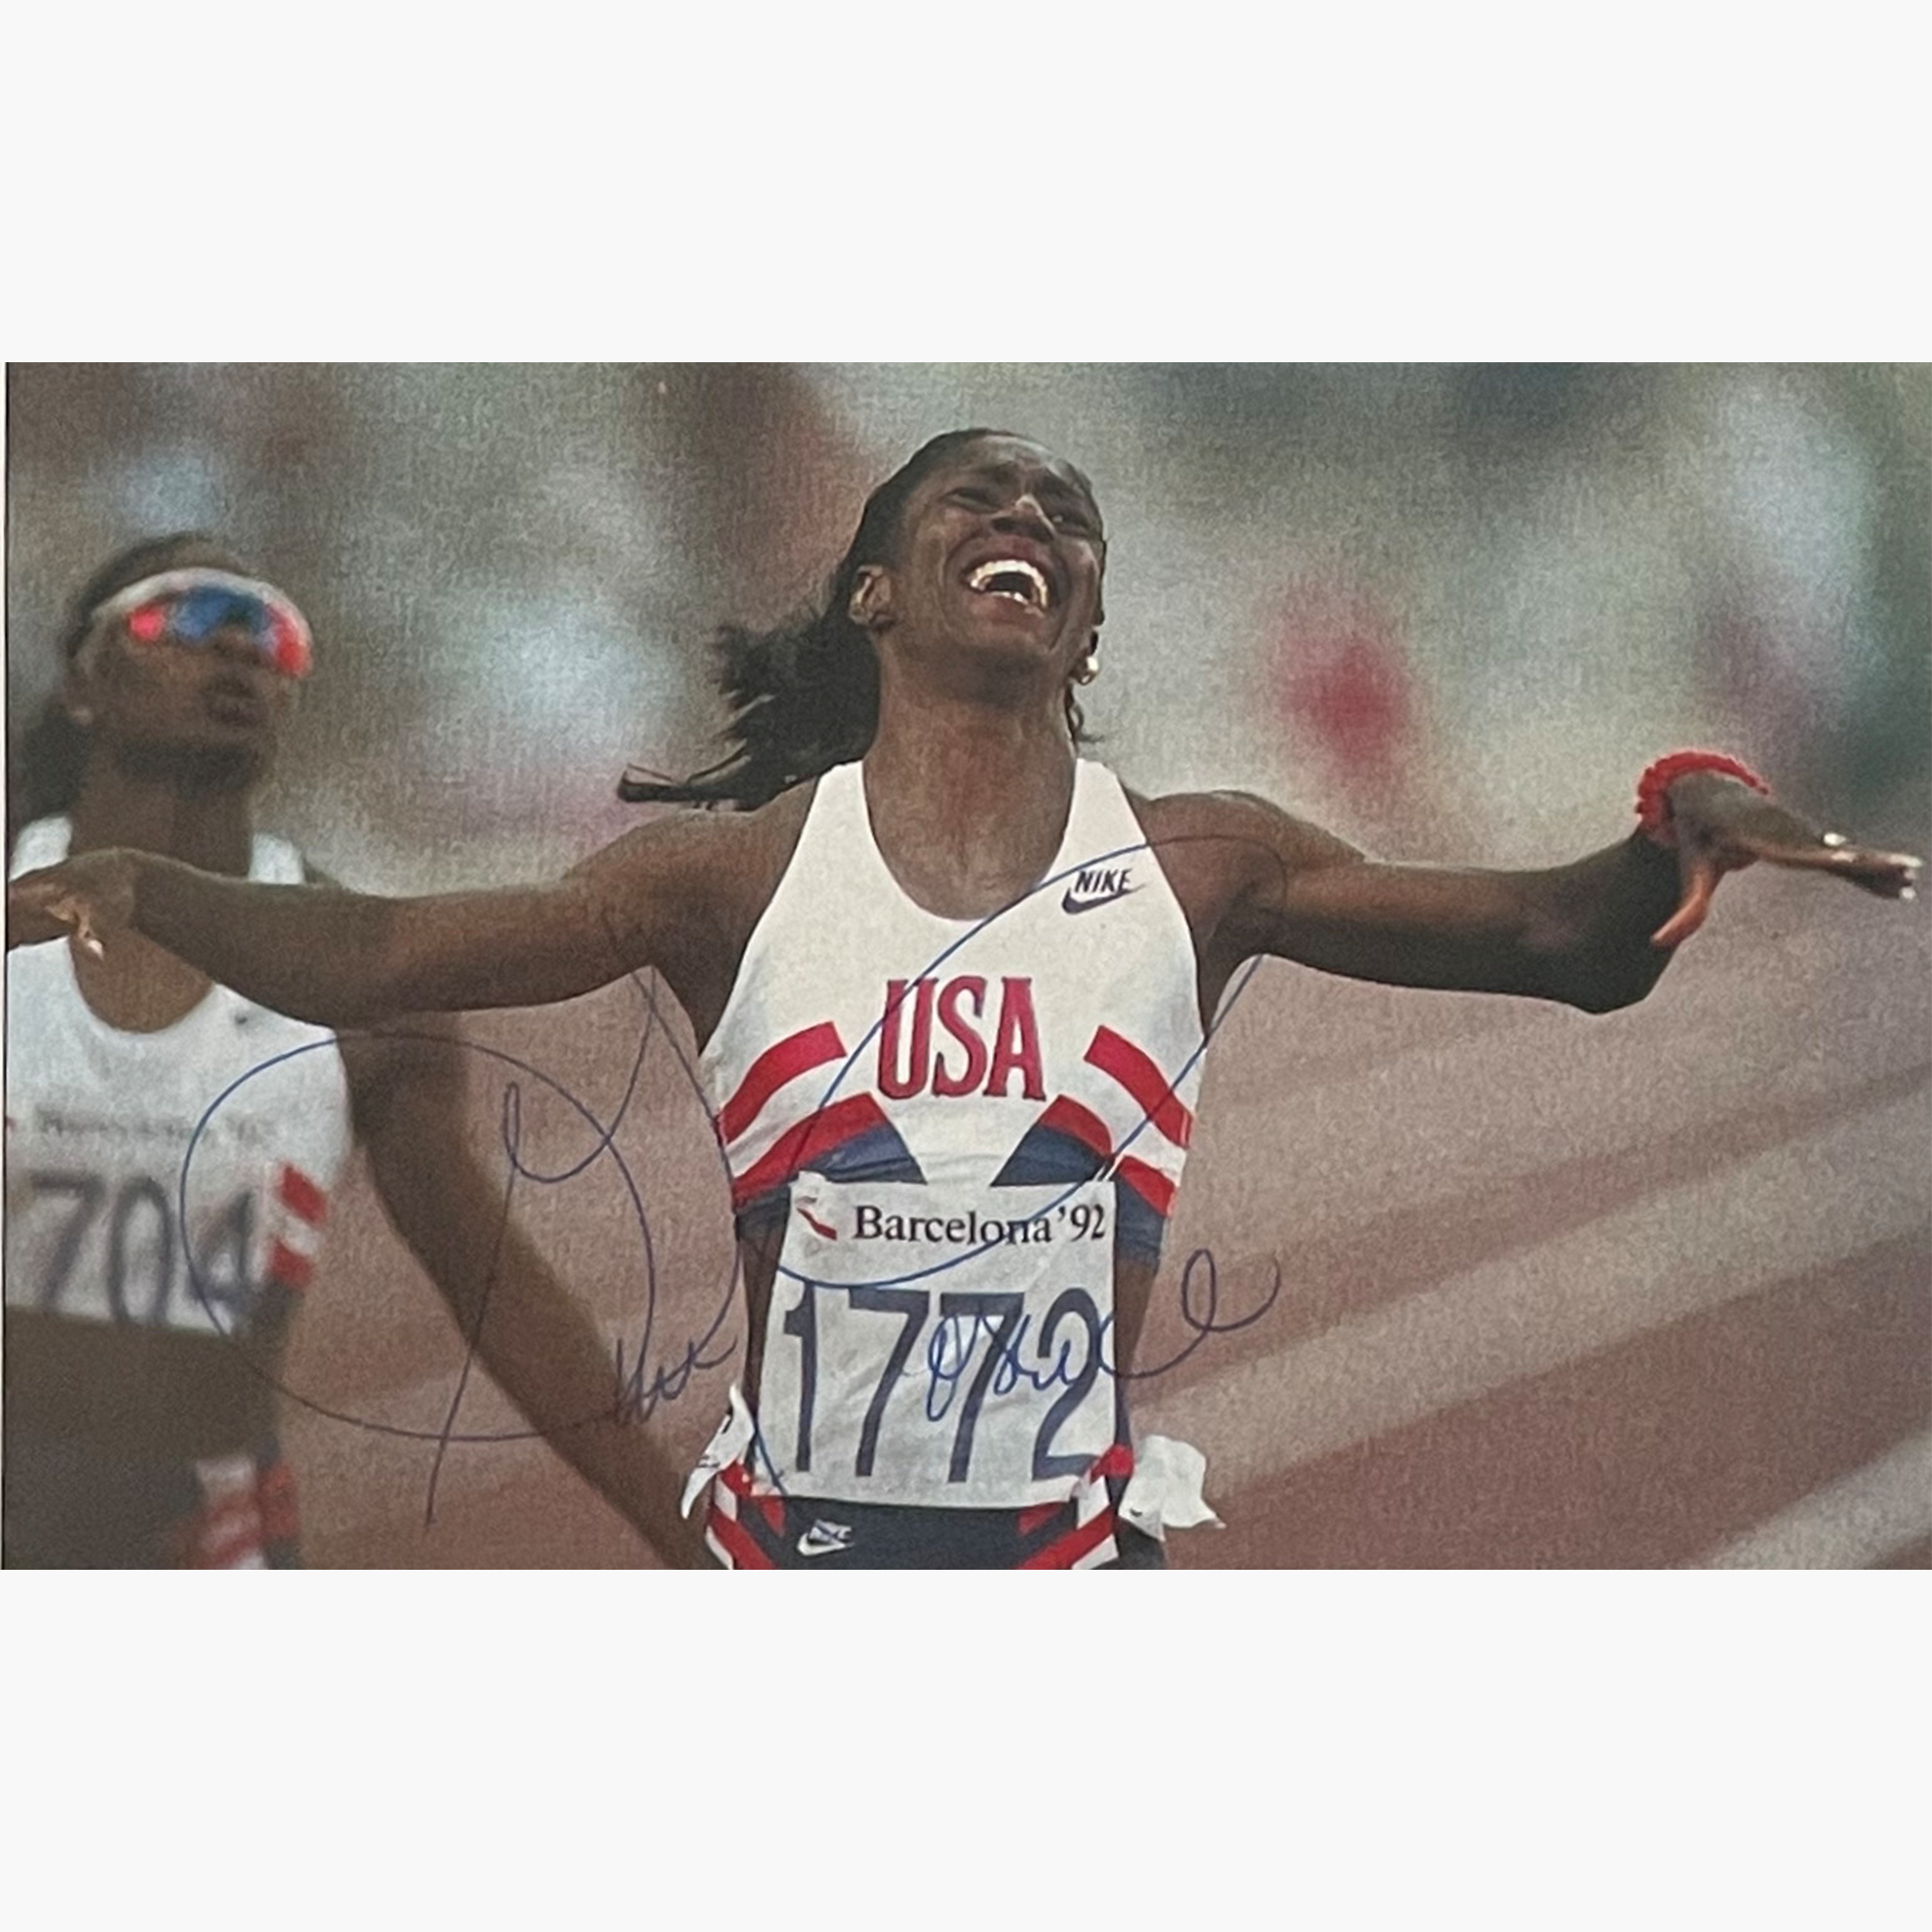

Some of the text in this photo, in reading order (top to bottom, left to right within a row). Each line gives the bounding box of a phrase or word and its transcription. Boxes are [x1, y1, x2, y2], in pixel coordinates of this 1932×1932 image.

[1074, 868, 1132, 894] NIKE
[877, 975, 1046, 1100] USA
[30, 1170, 256, 1326] 704
[783, 1282, 1108, 1483] 1772
